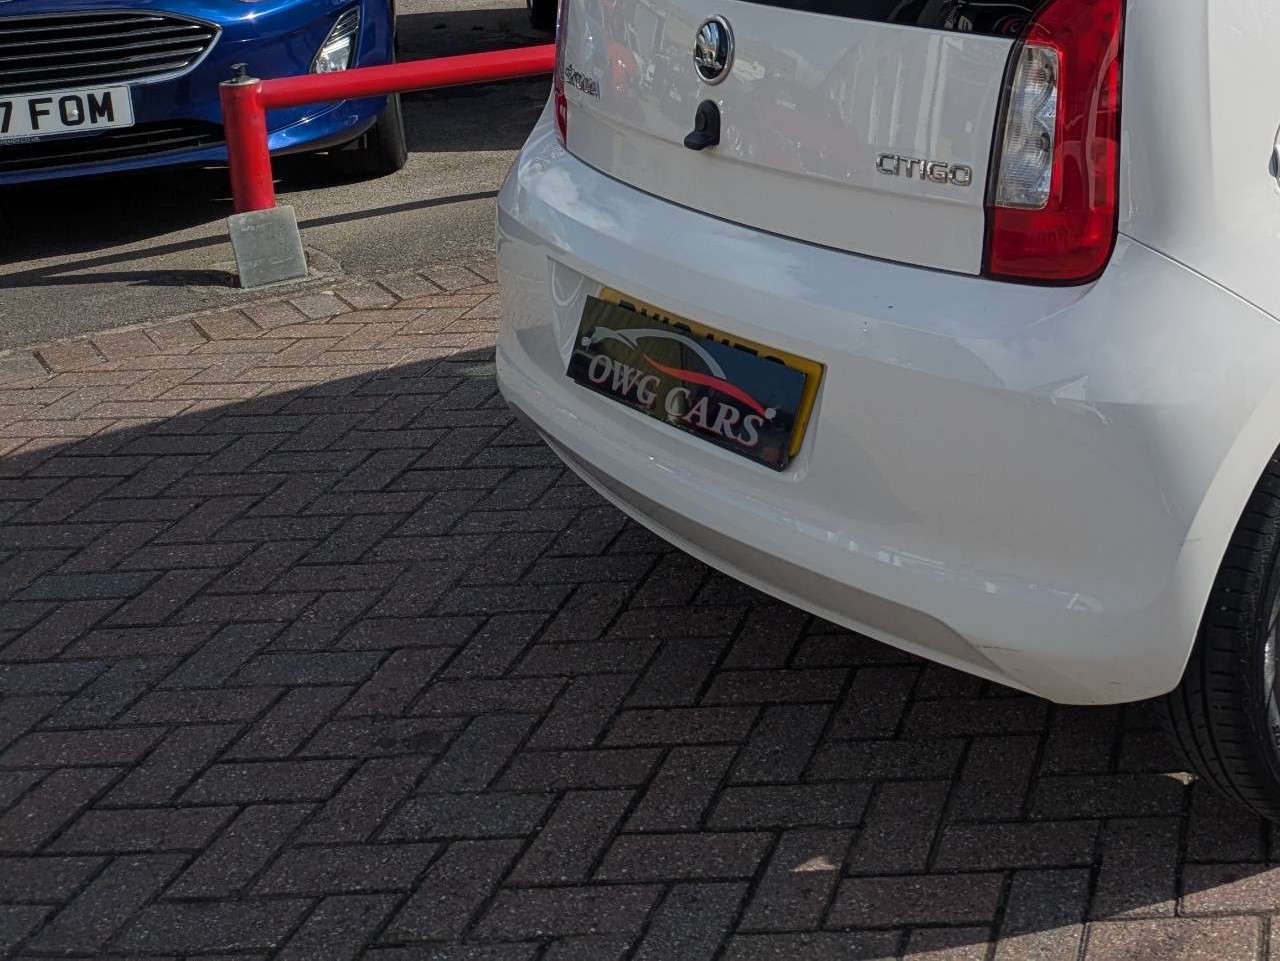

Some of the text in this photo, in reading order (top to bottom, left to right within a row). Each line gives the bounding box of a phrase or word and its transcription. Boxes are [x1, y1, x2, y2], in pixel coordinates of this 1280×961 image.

[28, 91, 115, 131] FOM
[876, 152, 973, 186] CITIGO
[588, 354, 764, 446] OWG CARS
